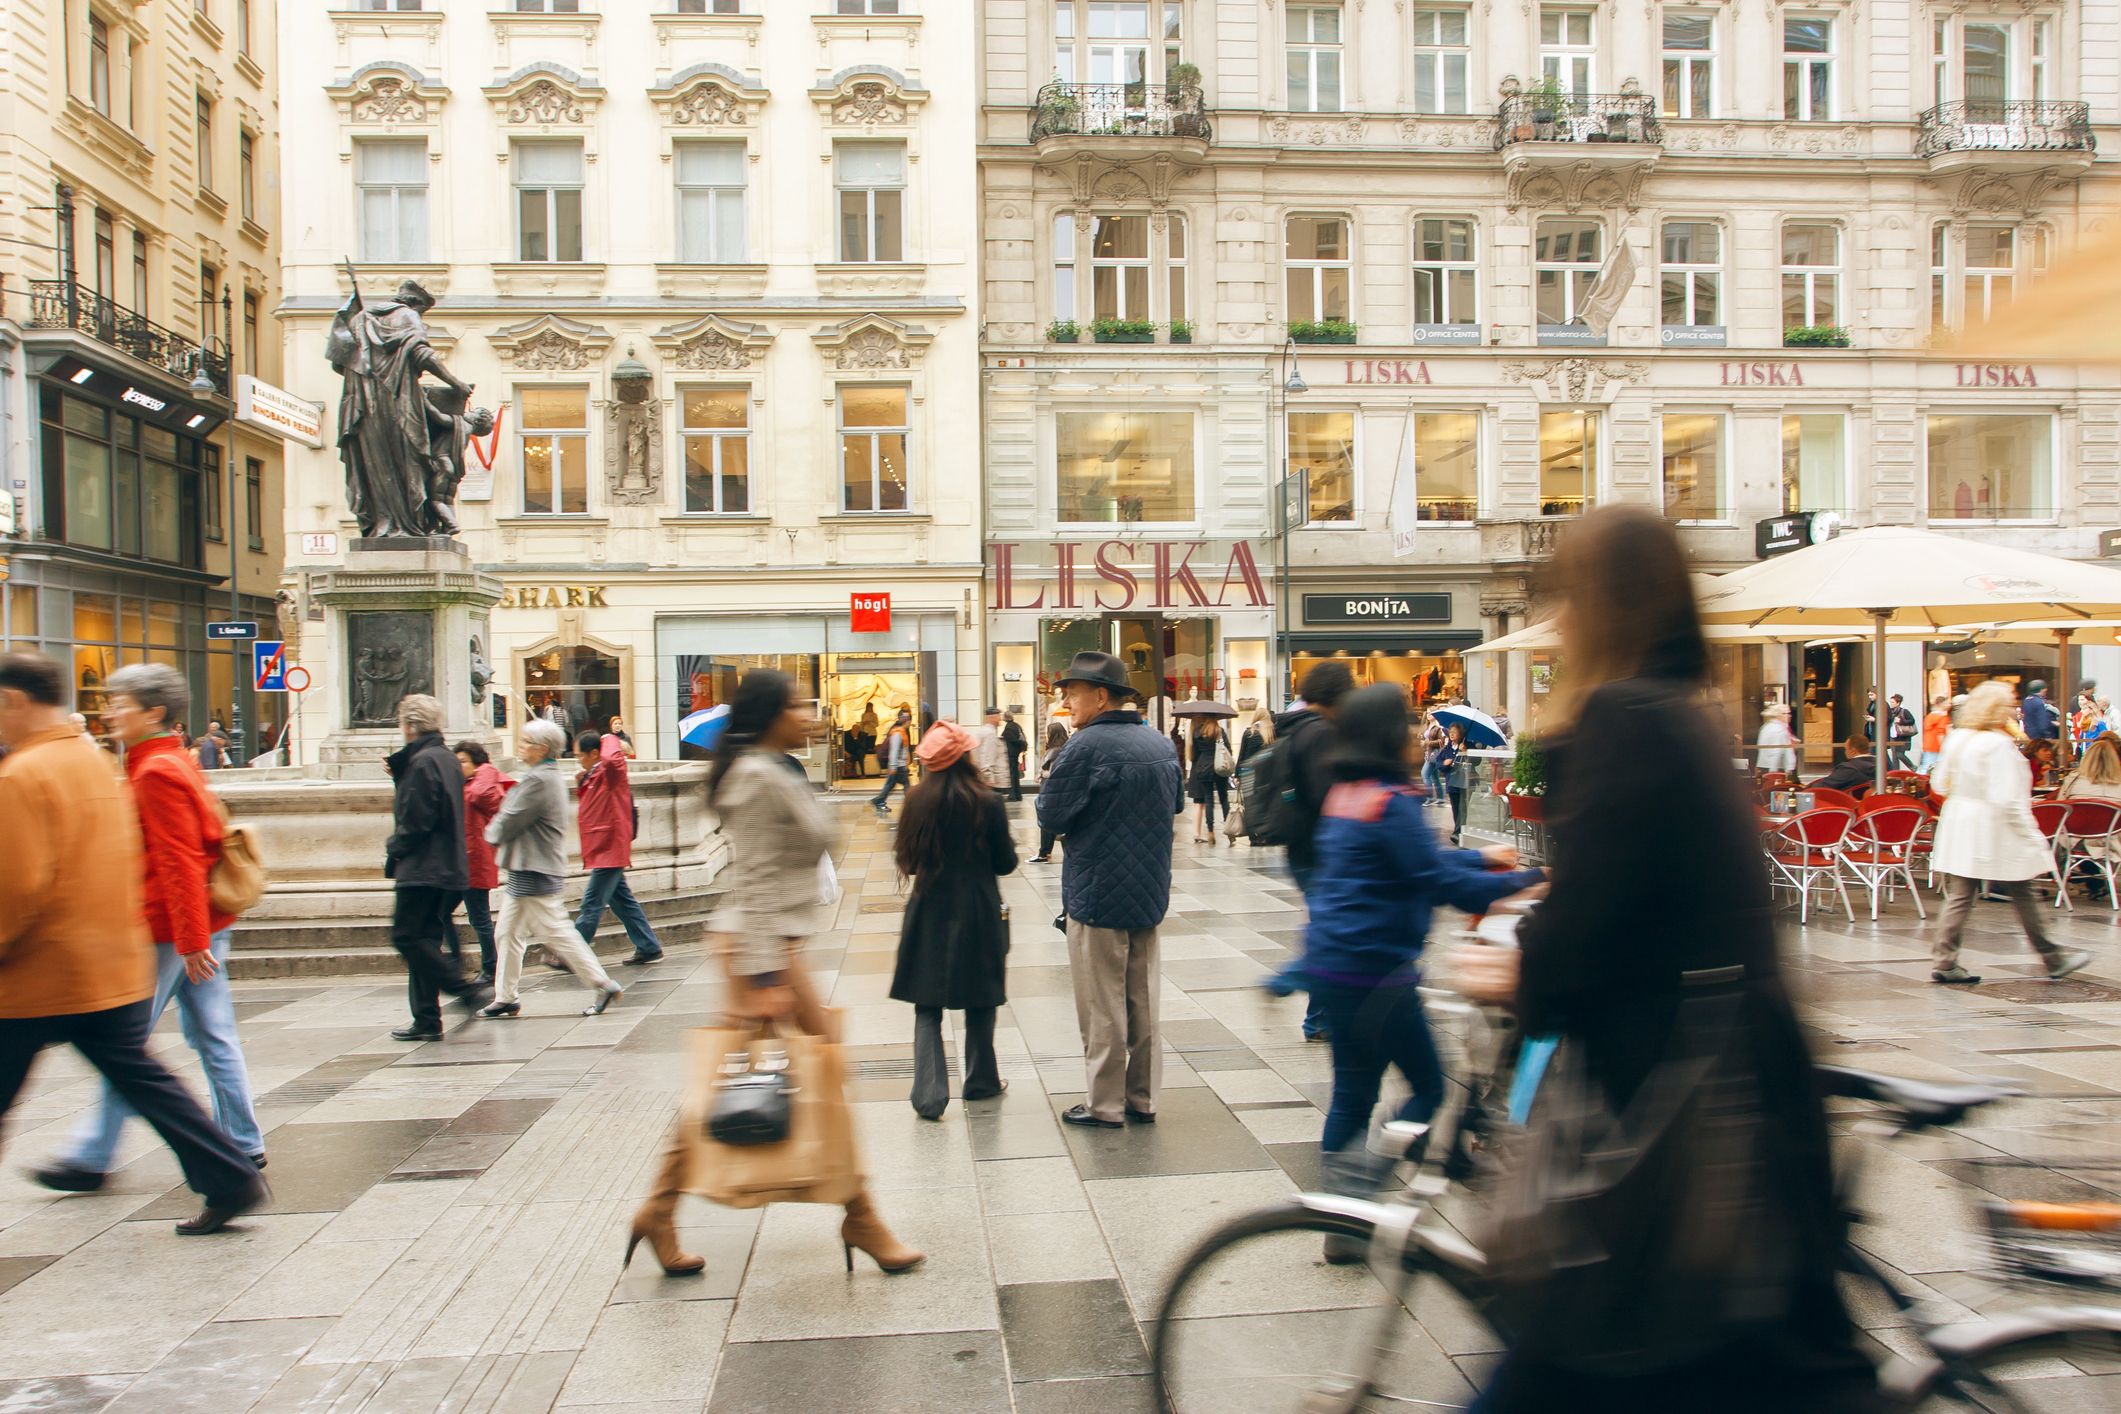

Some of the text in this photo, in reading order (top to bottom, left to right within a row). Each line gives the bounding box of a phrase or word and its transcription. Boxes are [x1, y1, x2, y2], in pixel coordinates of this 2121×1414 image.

[1344, 360, 1432, 384] LISKA
[1719, 361, 1806, 386] LISKA
[1953, 363, 2040, 388] LISKA
[313, 535, 326, 547] 11
[1772, 520, 1793, 538] IWC
[986, 540, 1276, 611] LISKA
[1164, 667, 1227, 692] SALE
